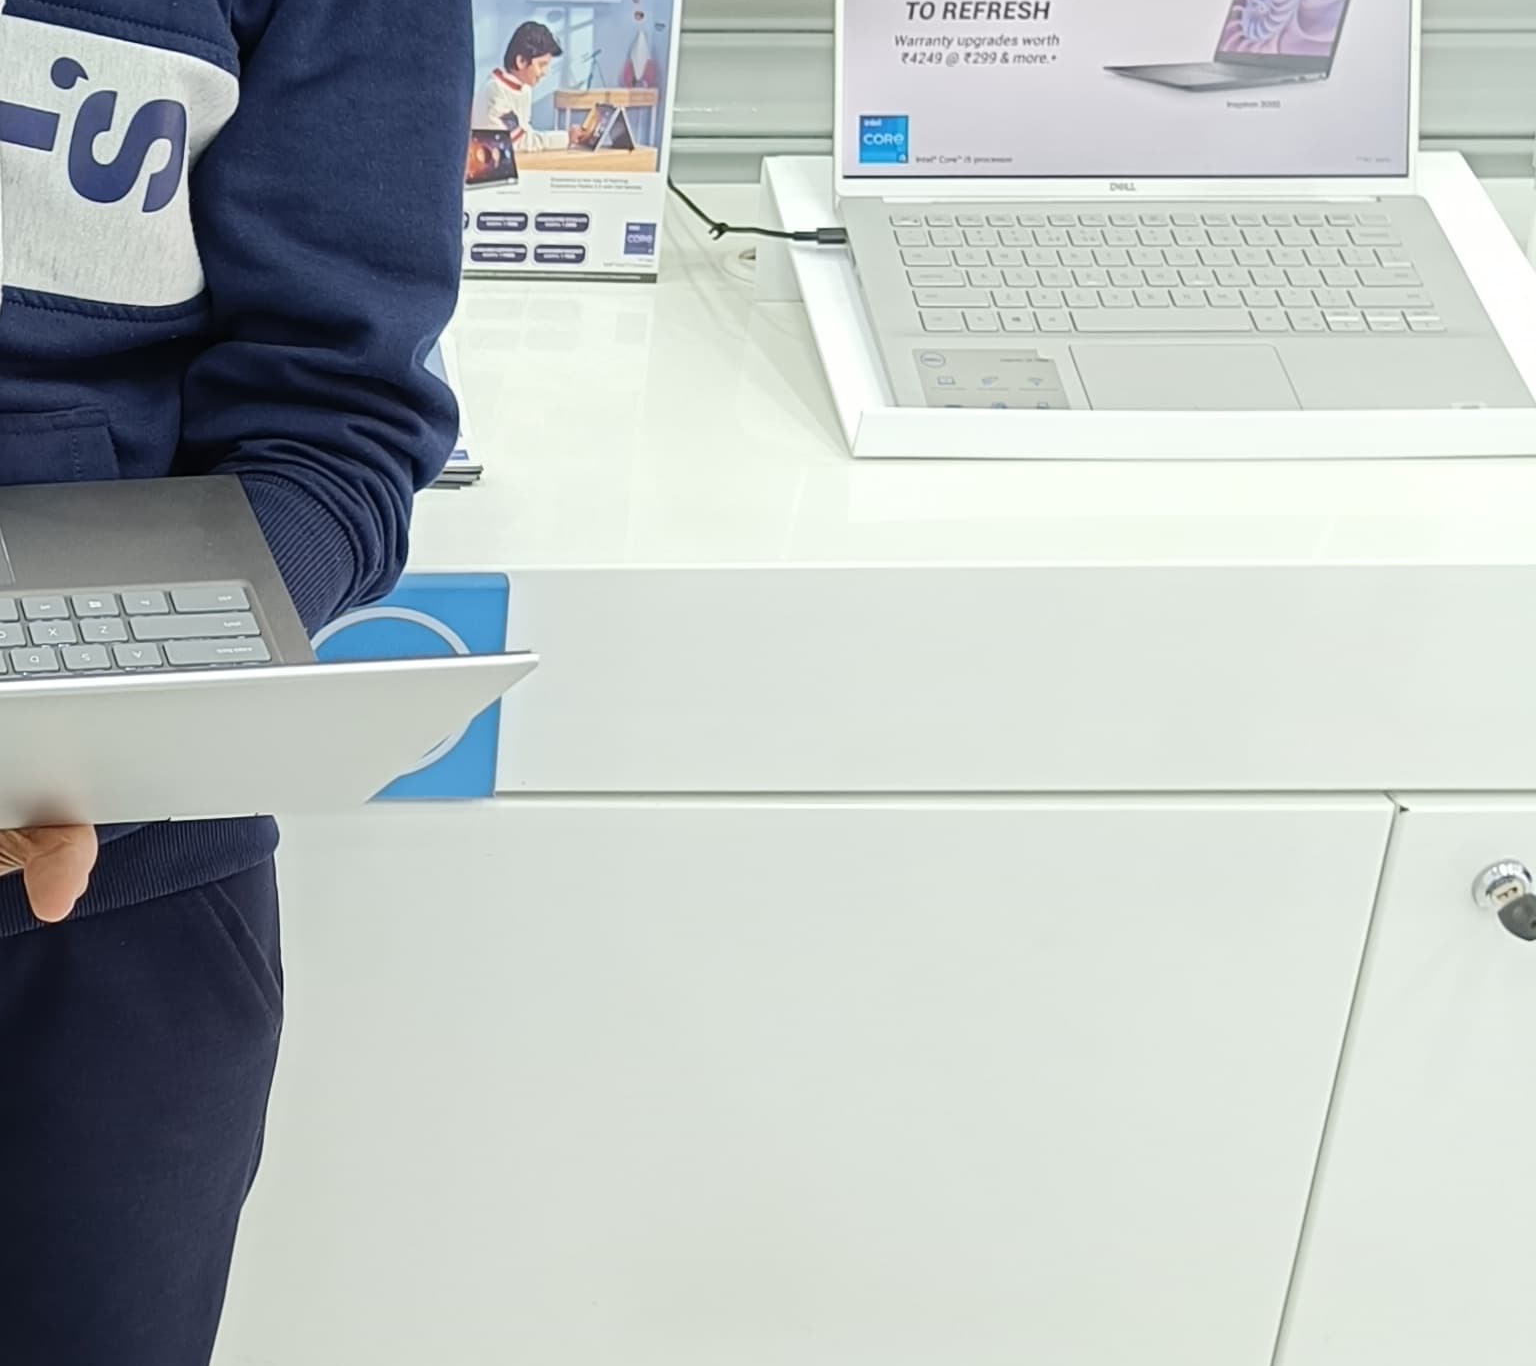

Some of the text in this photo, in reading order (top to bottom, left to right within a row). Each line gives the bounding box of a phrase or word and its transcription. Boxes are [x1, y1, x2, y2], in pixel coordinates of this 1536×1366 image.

[906, 1, 1051, 20] TO REFRESH
[894, 34, 1060, 50] Warranty upgrades worth
[946, 52, 959, 66] @
[963, 52, 997, 65] ₹299
[1000, 52, 1010, 65] &
